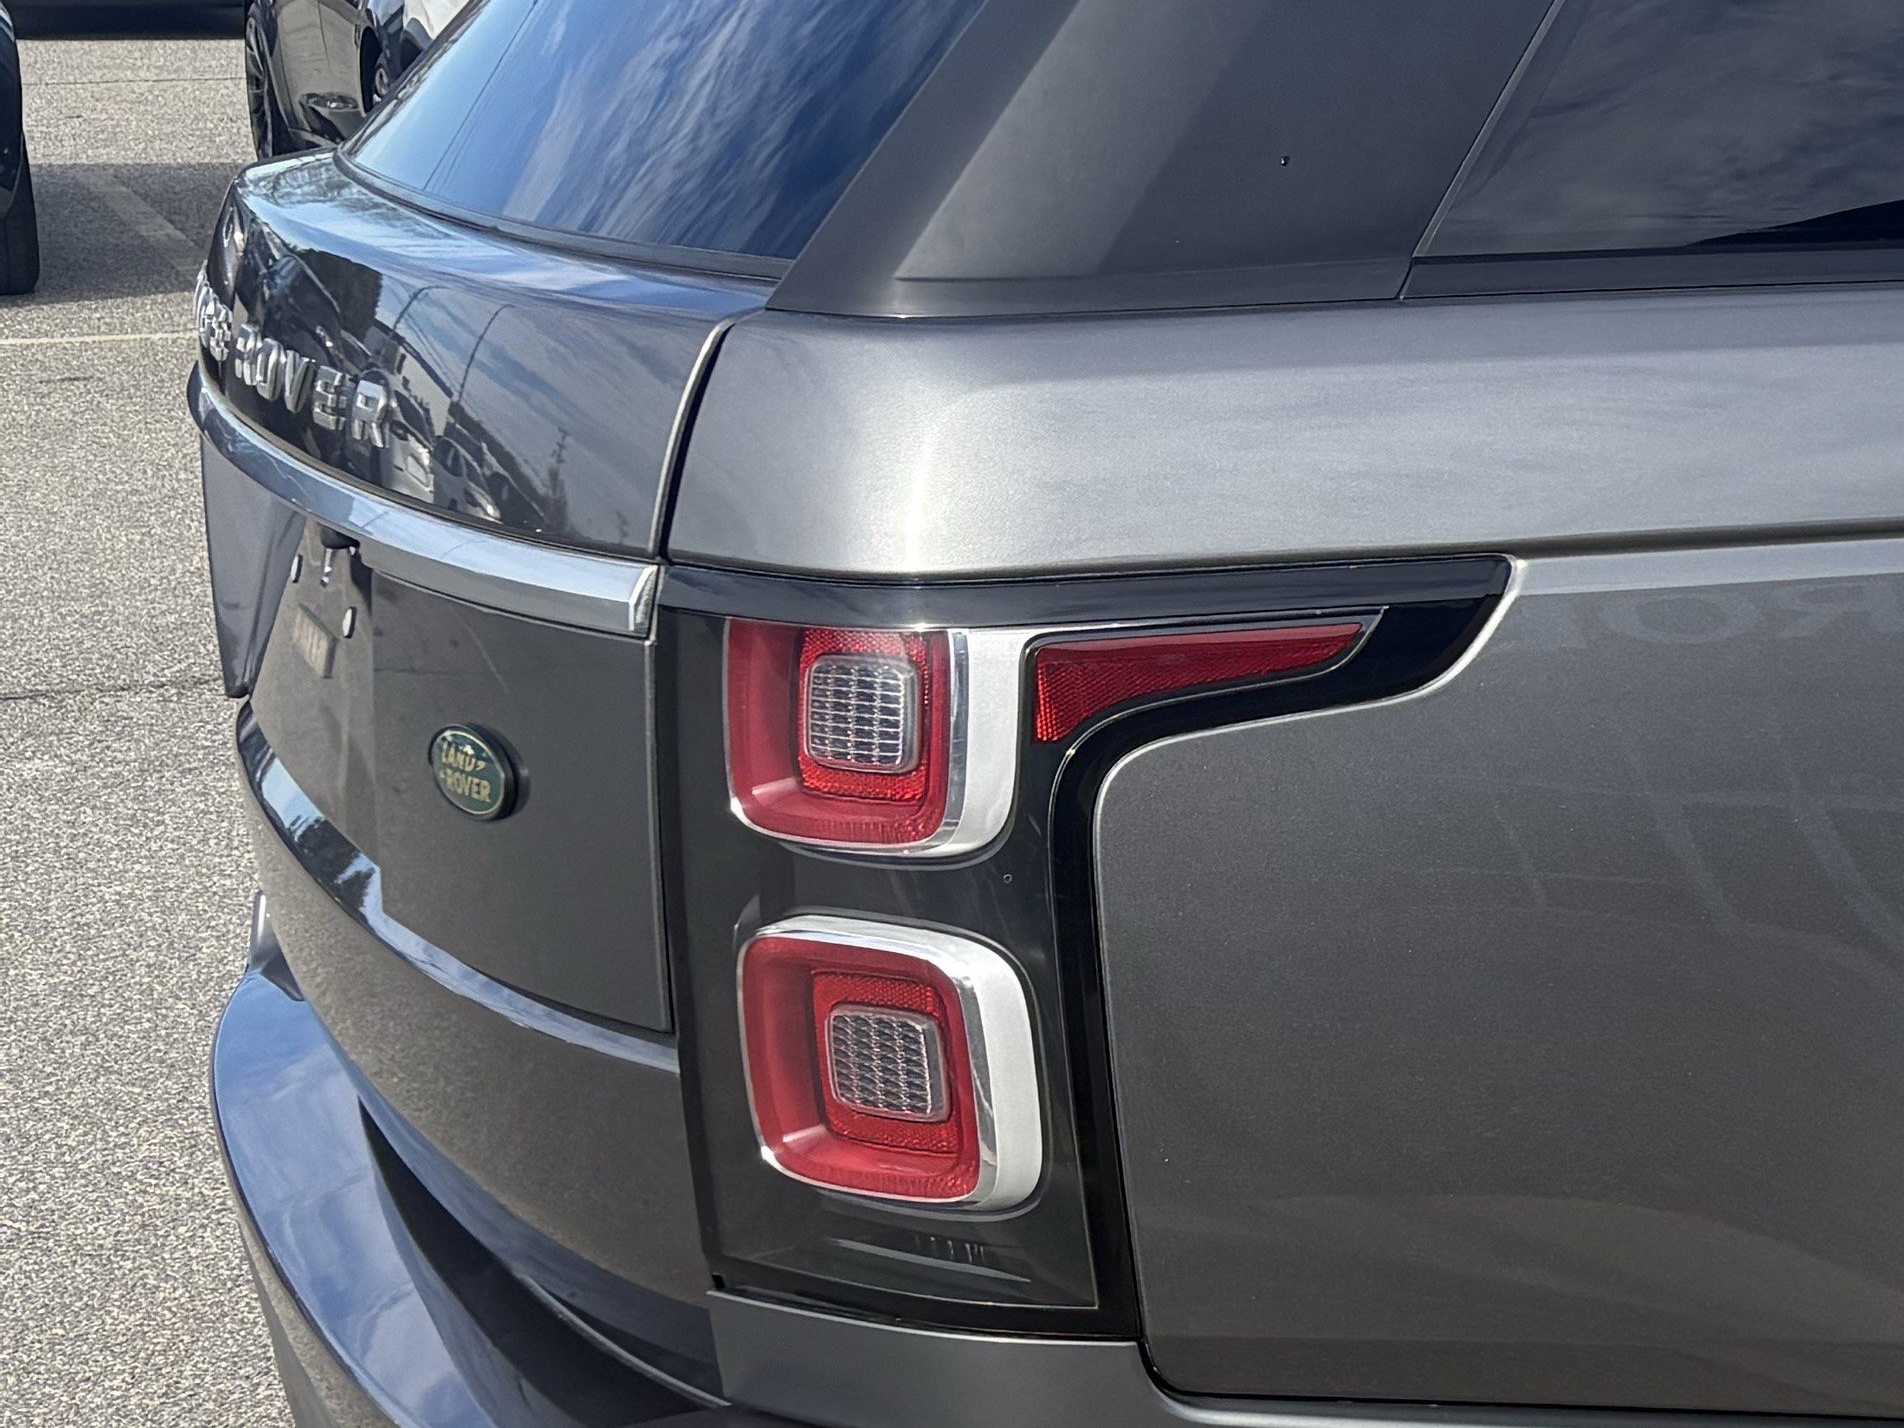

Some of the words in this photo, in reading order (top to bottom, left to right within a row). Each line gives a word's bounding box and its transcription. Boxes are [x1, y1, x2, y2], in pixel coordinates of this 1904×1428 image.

[235, 322, 390, 449] ROVER
[442, 738, 476, 772] LAND
[446, 768, 491, 803] ROVER
